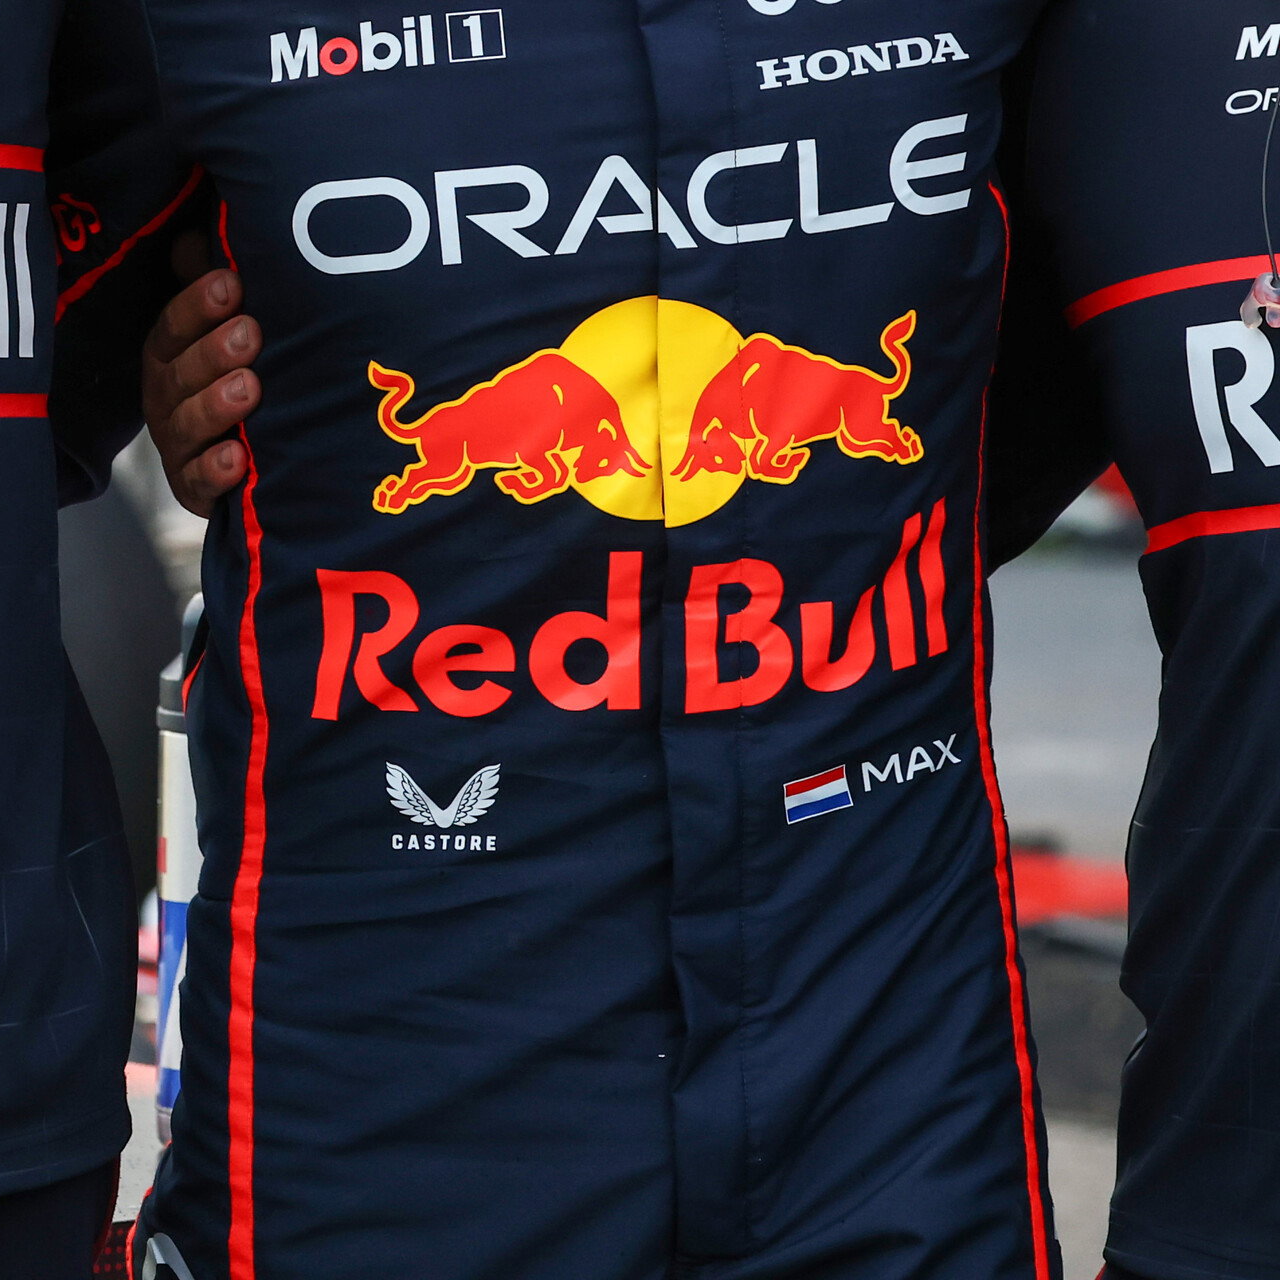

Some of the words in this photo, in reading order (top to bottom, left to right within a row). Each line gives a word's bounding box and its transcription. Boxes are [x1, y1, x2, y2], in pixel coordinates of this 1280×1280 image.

[269, 14, 436, 84] Mobil
[756, 32, 970, 90] HONDA
[291, 113, 972, 276] ORACLE
[311, 551, 643, 721] Red
[683, 496, 947, 714] Bull
[861, 733, 962, 793] MAX
[391, 834, 497, 851] CASTORE
